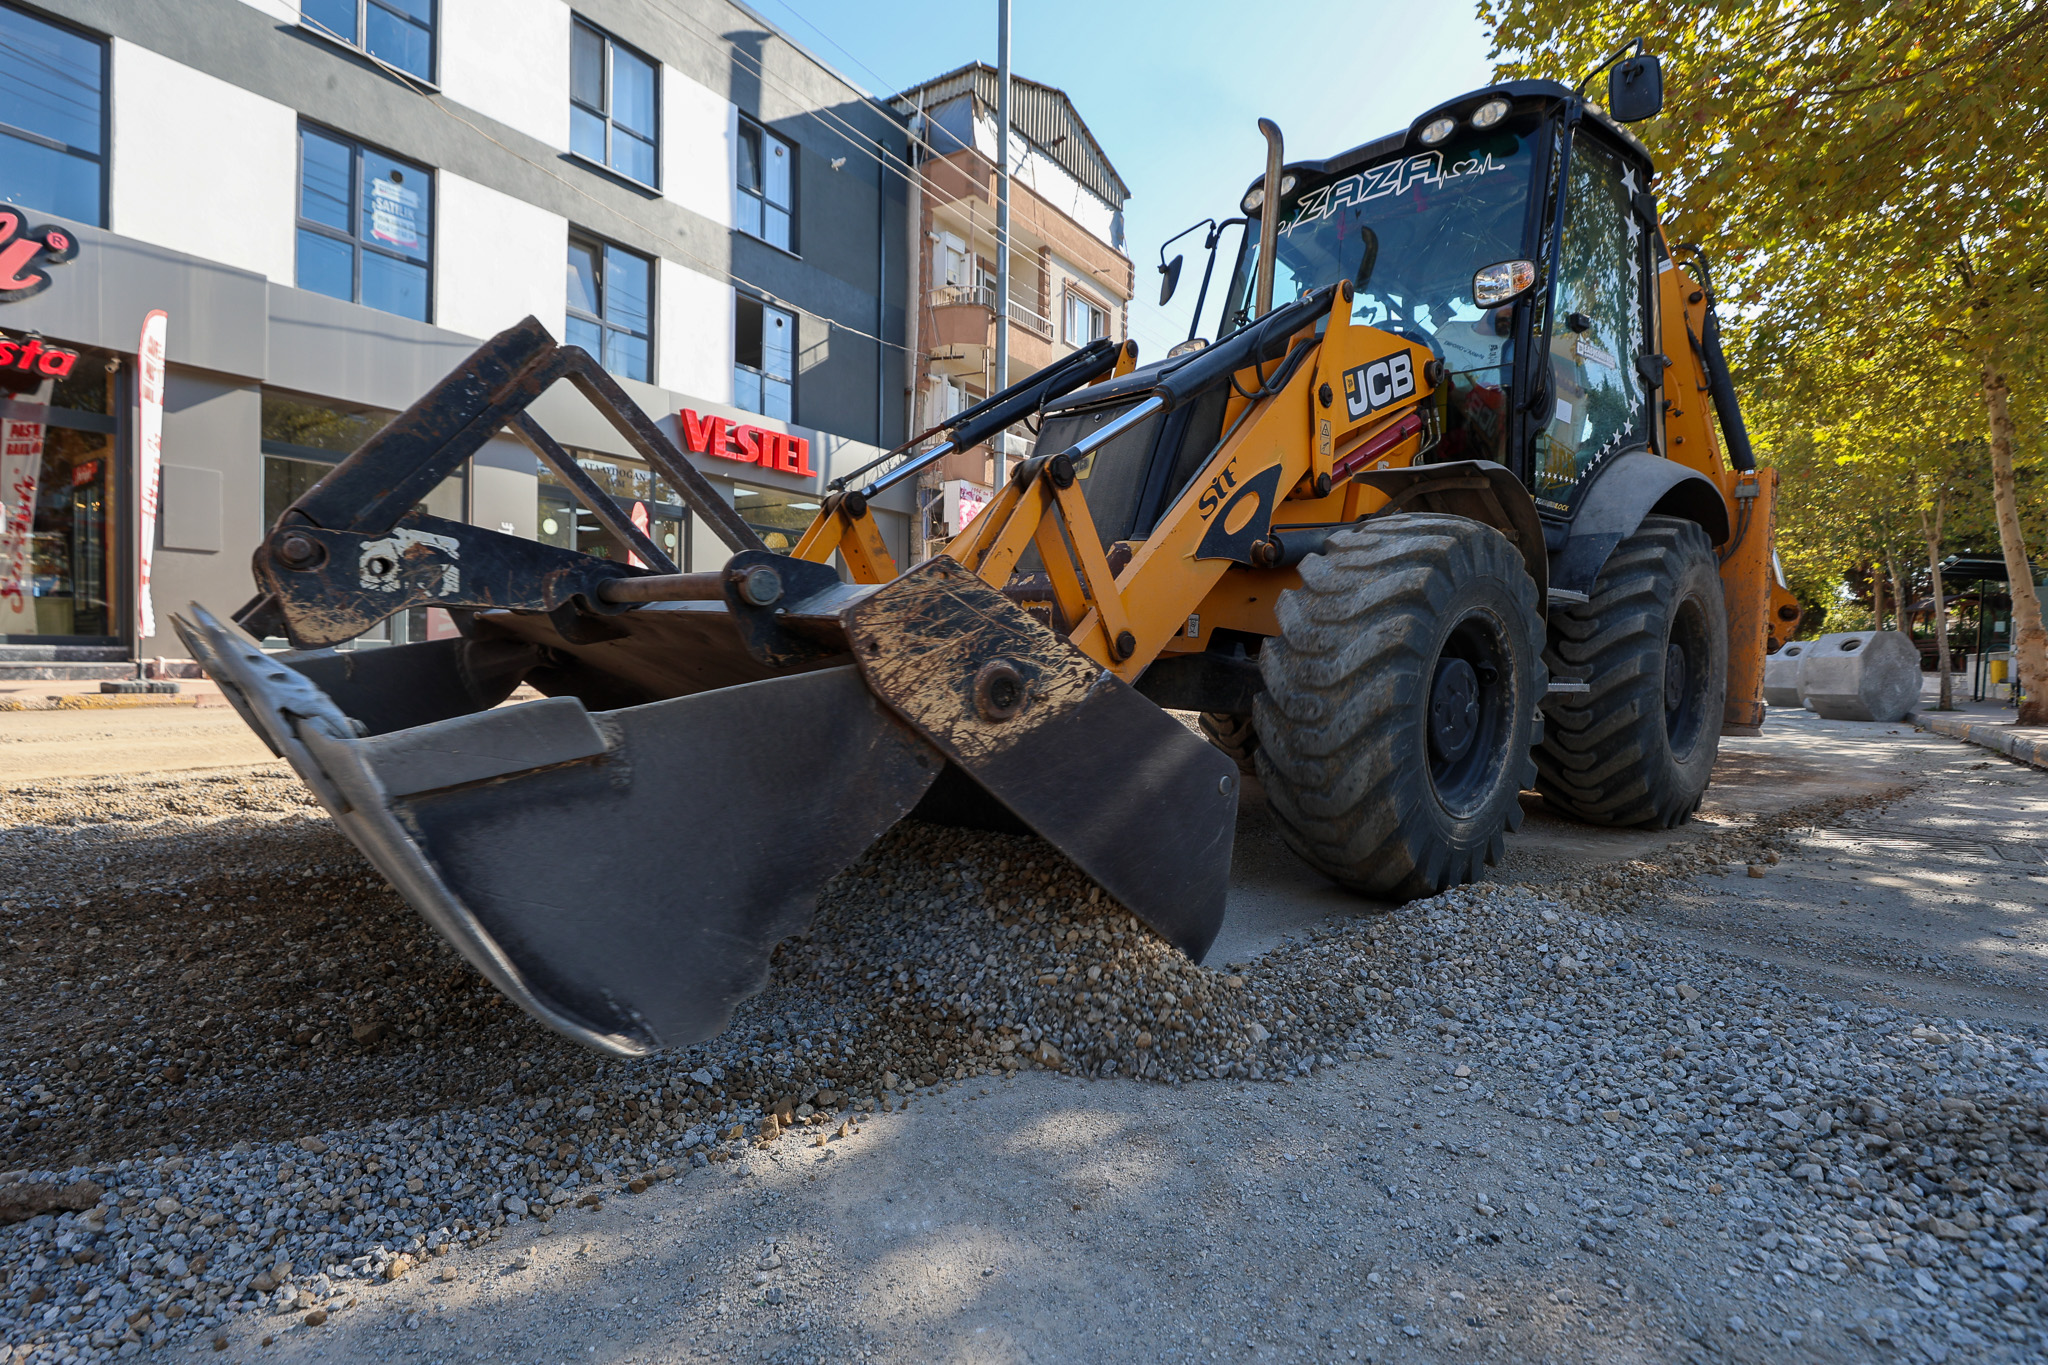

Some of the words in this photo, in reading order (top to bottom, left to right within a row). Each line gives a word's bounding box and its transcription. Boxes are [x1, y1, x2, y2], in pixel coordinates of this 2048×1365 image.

[1292, 150, 1443, 229] ZAZA
[1348, 354, 1413, 416] JCB
[680, 408, 817, 478] VESTEL
